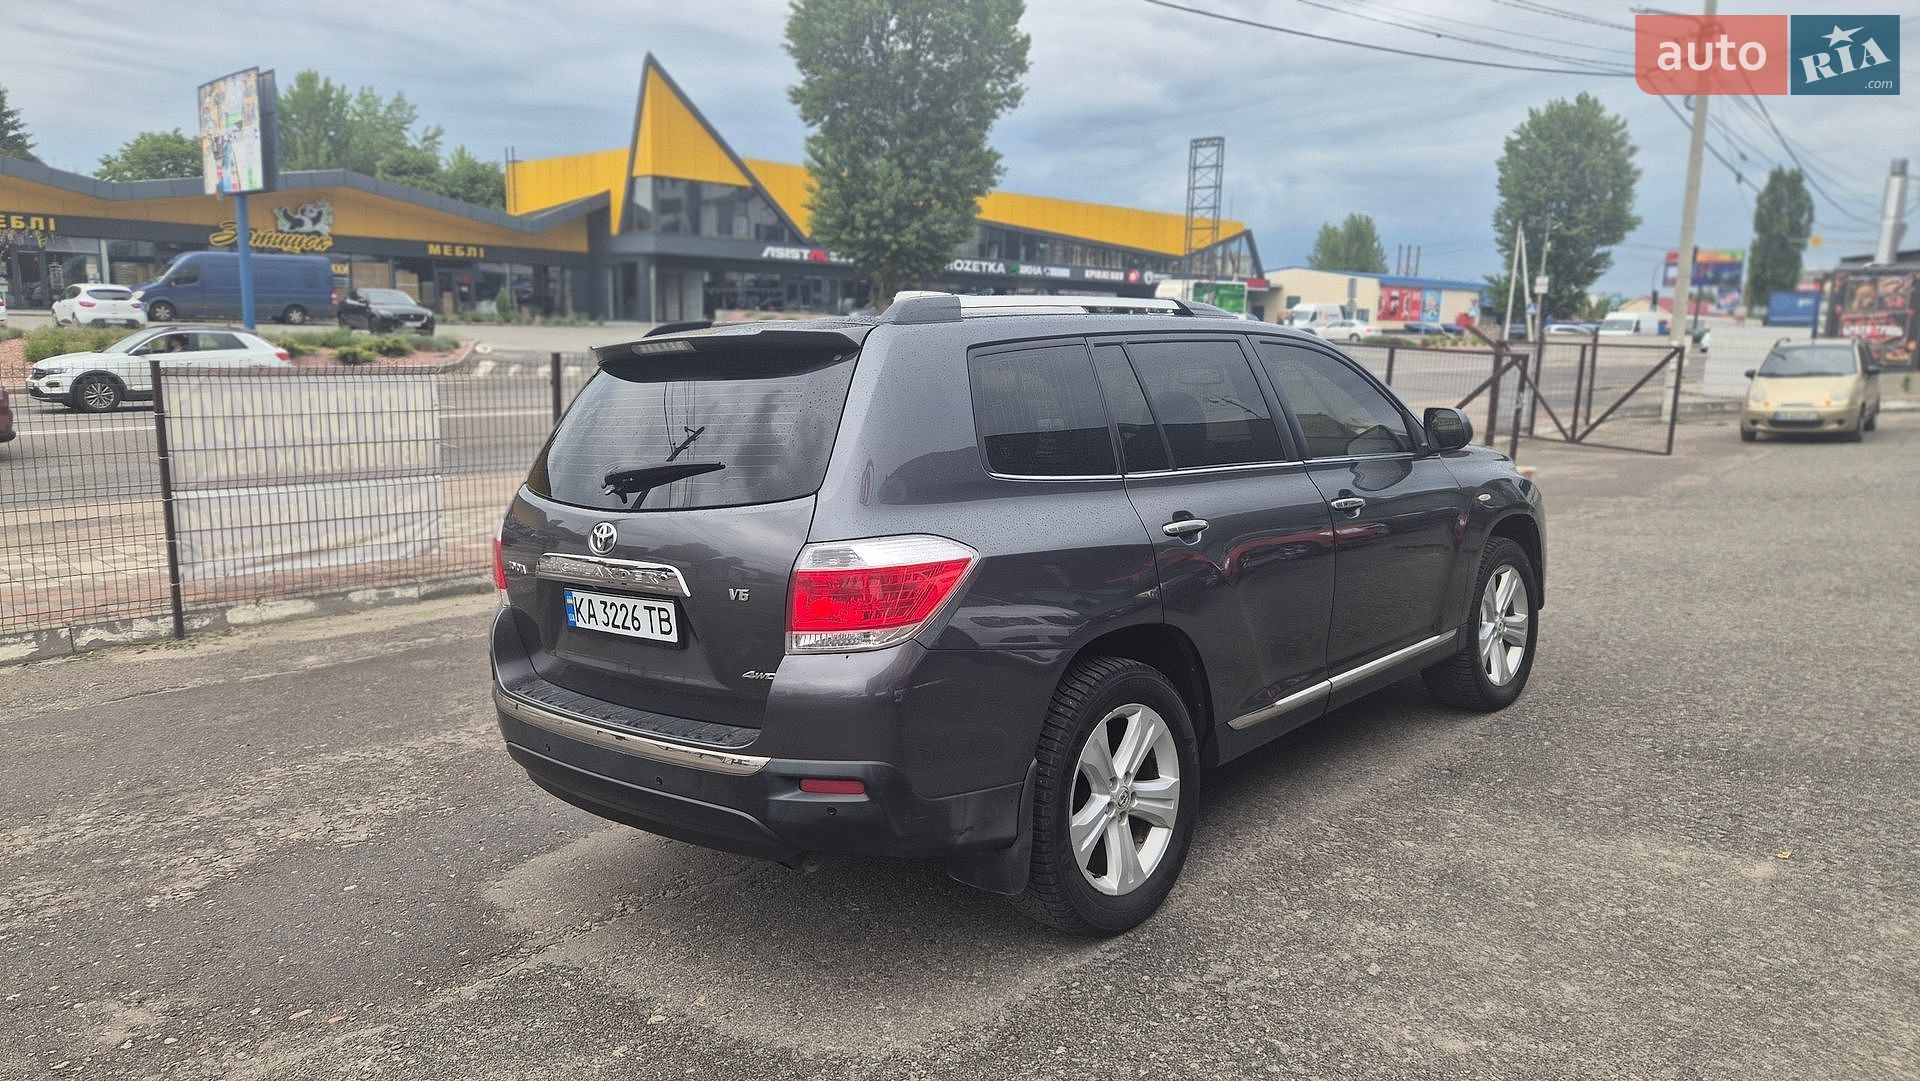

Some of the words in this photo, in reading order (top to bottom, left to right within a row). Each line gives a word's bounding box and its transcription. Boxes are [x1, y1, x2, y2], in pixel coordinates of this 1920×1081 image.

[427, 243, 485, 258] МЕБЛІ
[728, 588, 749, 601] V6
[574, 596, 599, 626] KA
[600, 600, 641, 632] 3226
[643, 604, 673, 635] TB
